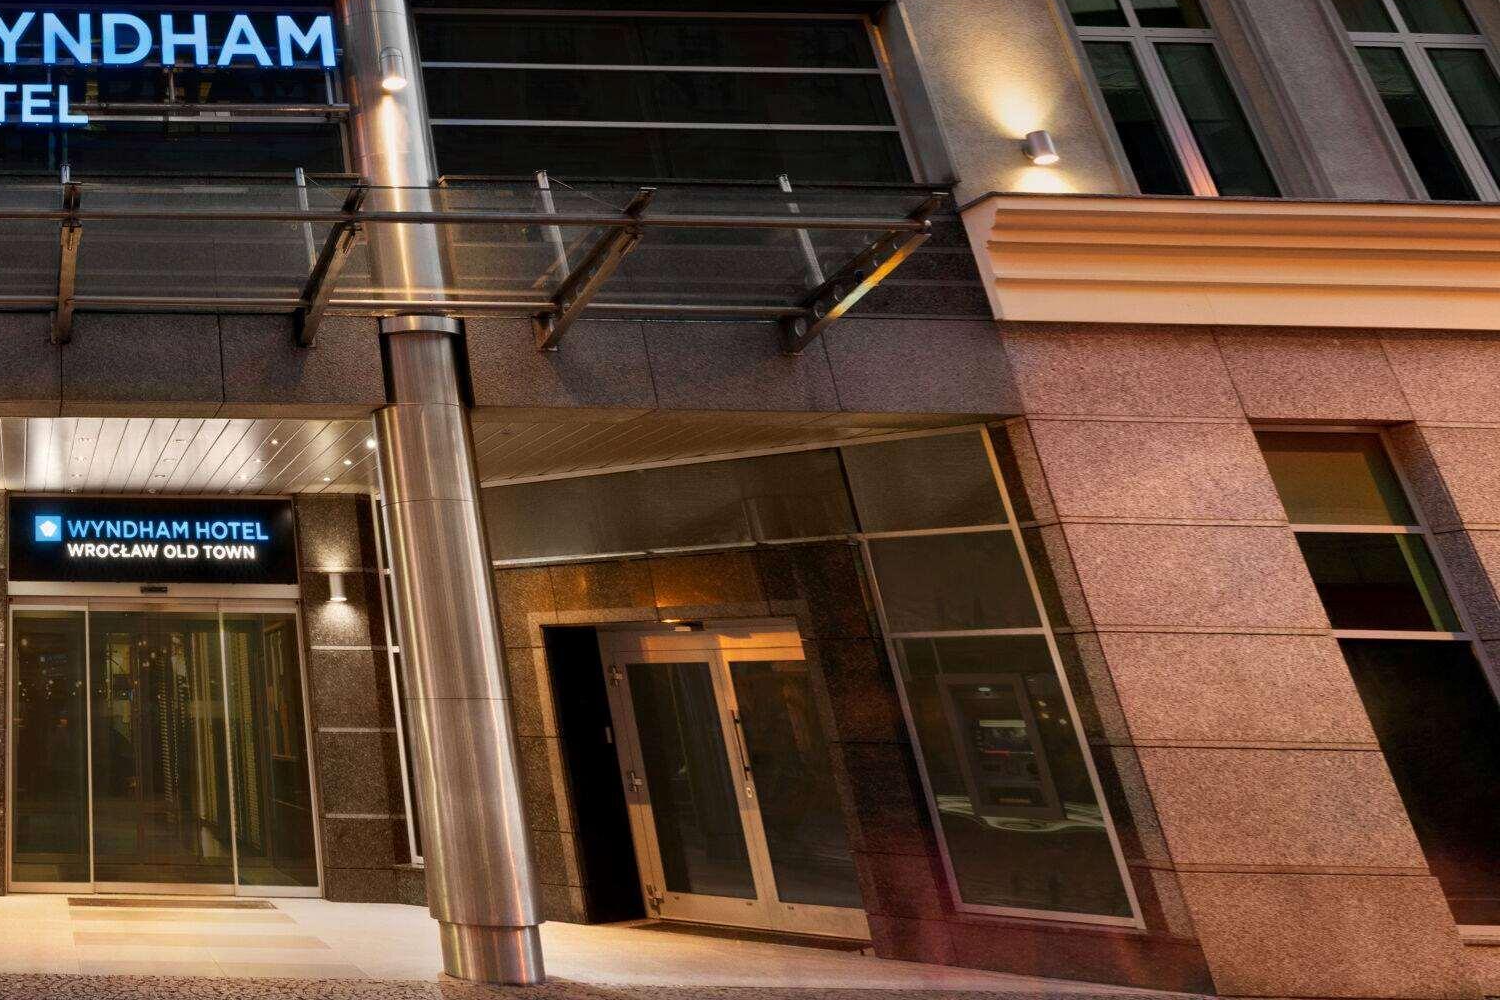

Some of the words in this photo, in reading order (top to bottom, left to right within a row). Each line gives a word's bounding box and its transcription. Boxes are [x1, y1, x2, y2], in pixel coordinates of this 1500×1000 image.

[67, 519, 190, 539] WYNDHAM
[195, 521, 269, 540] HOTEL
[66, 543, 159, 559] WROCŁAW
[163, 544, 199, 559] OLD
[202, 544, 256, 560] TOWN
